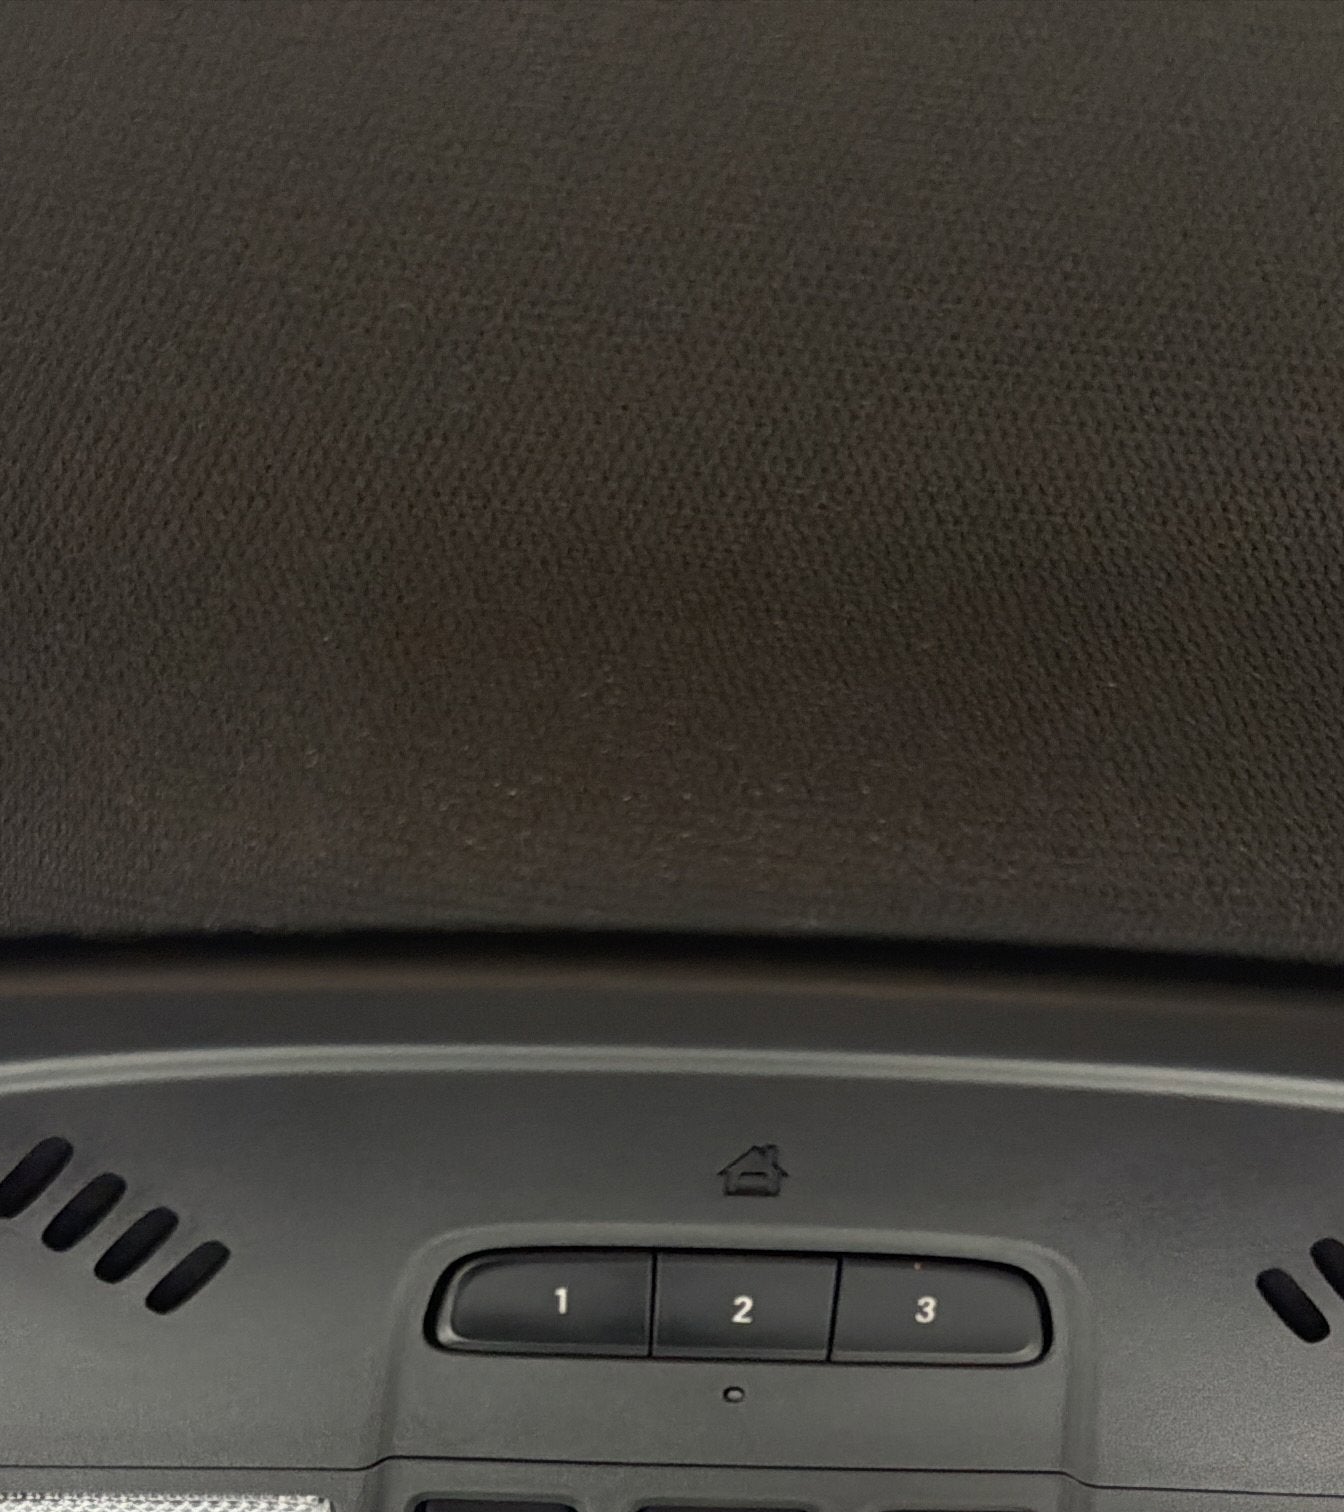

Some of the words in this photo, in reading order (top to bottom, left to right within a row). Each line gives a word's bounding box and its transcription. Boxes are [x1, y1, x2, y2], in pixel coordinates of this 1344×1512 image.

[553, 1287, 568, 1314] 1
[732, 1295, 753, 1323] 2
[915, 1296, 937, 1323] 3
